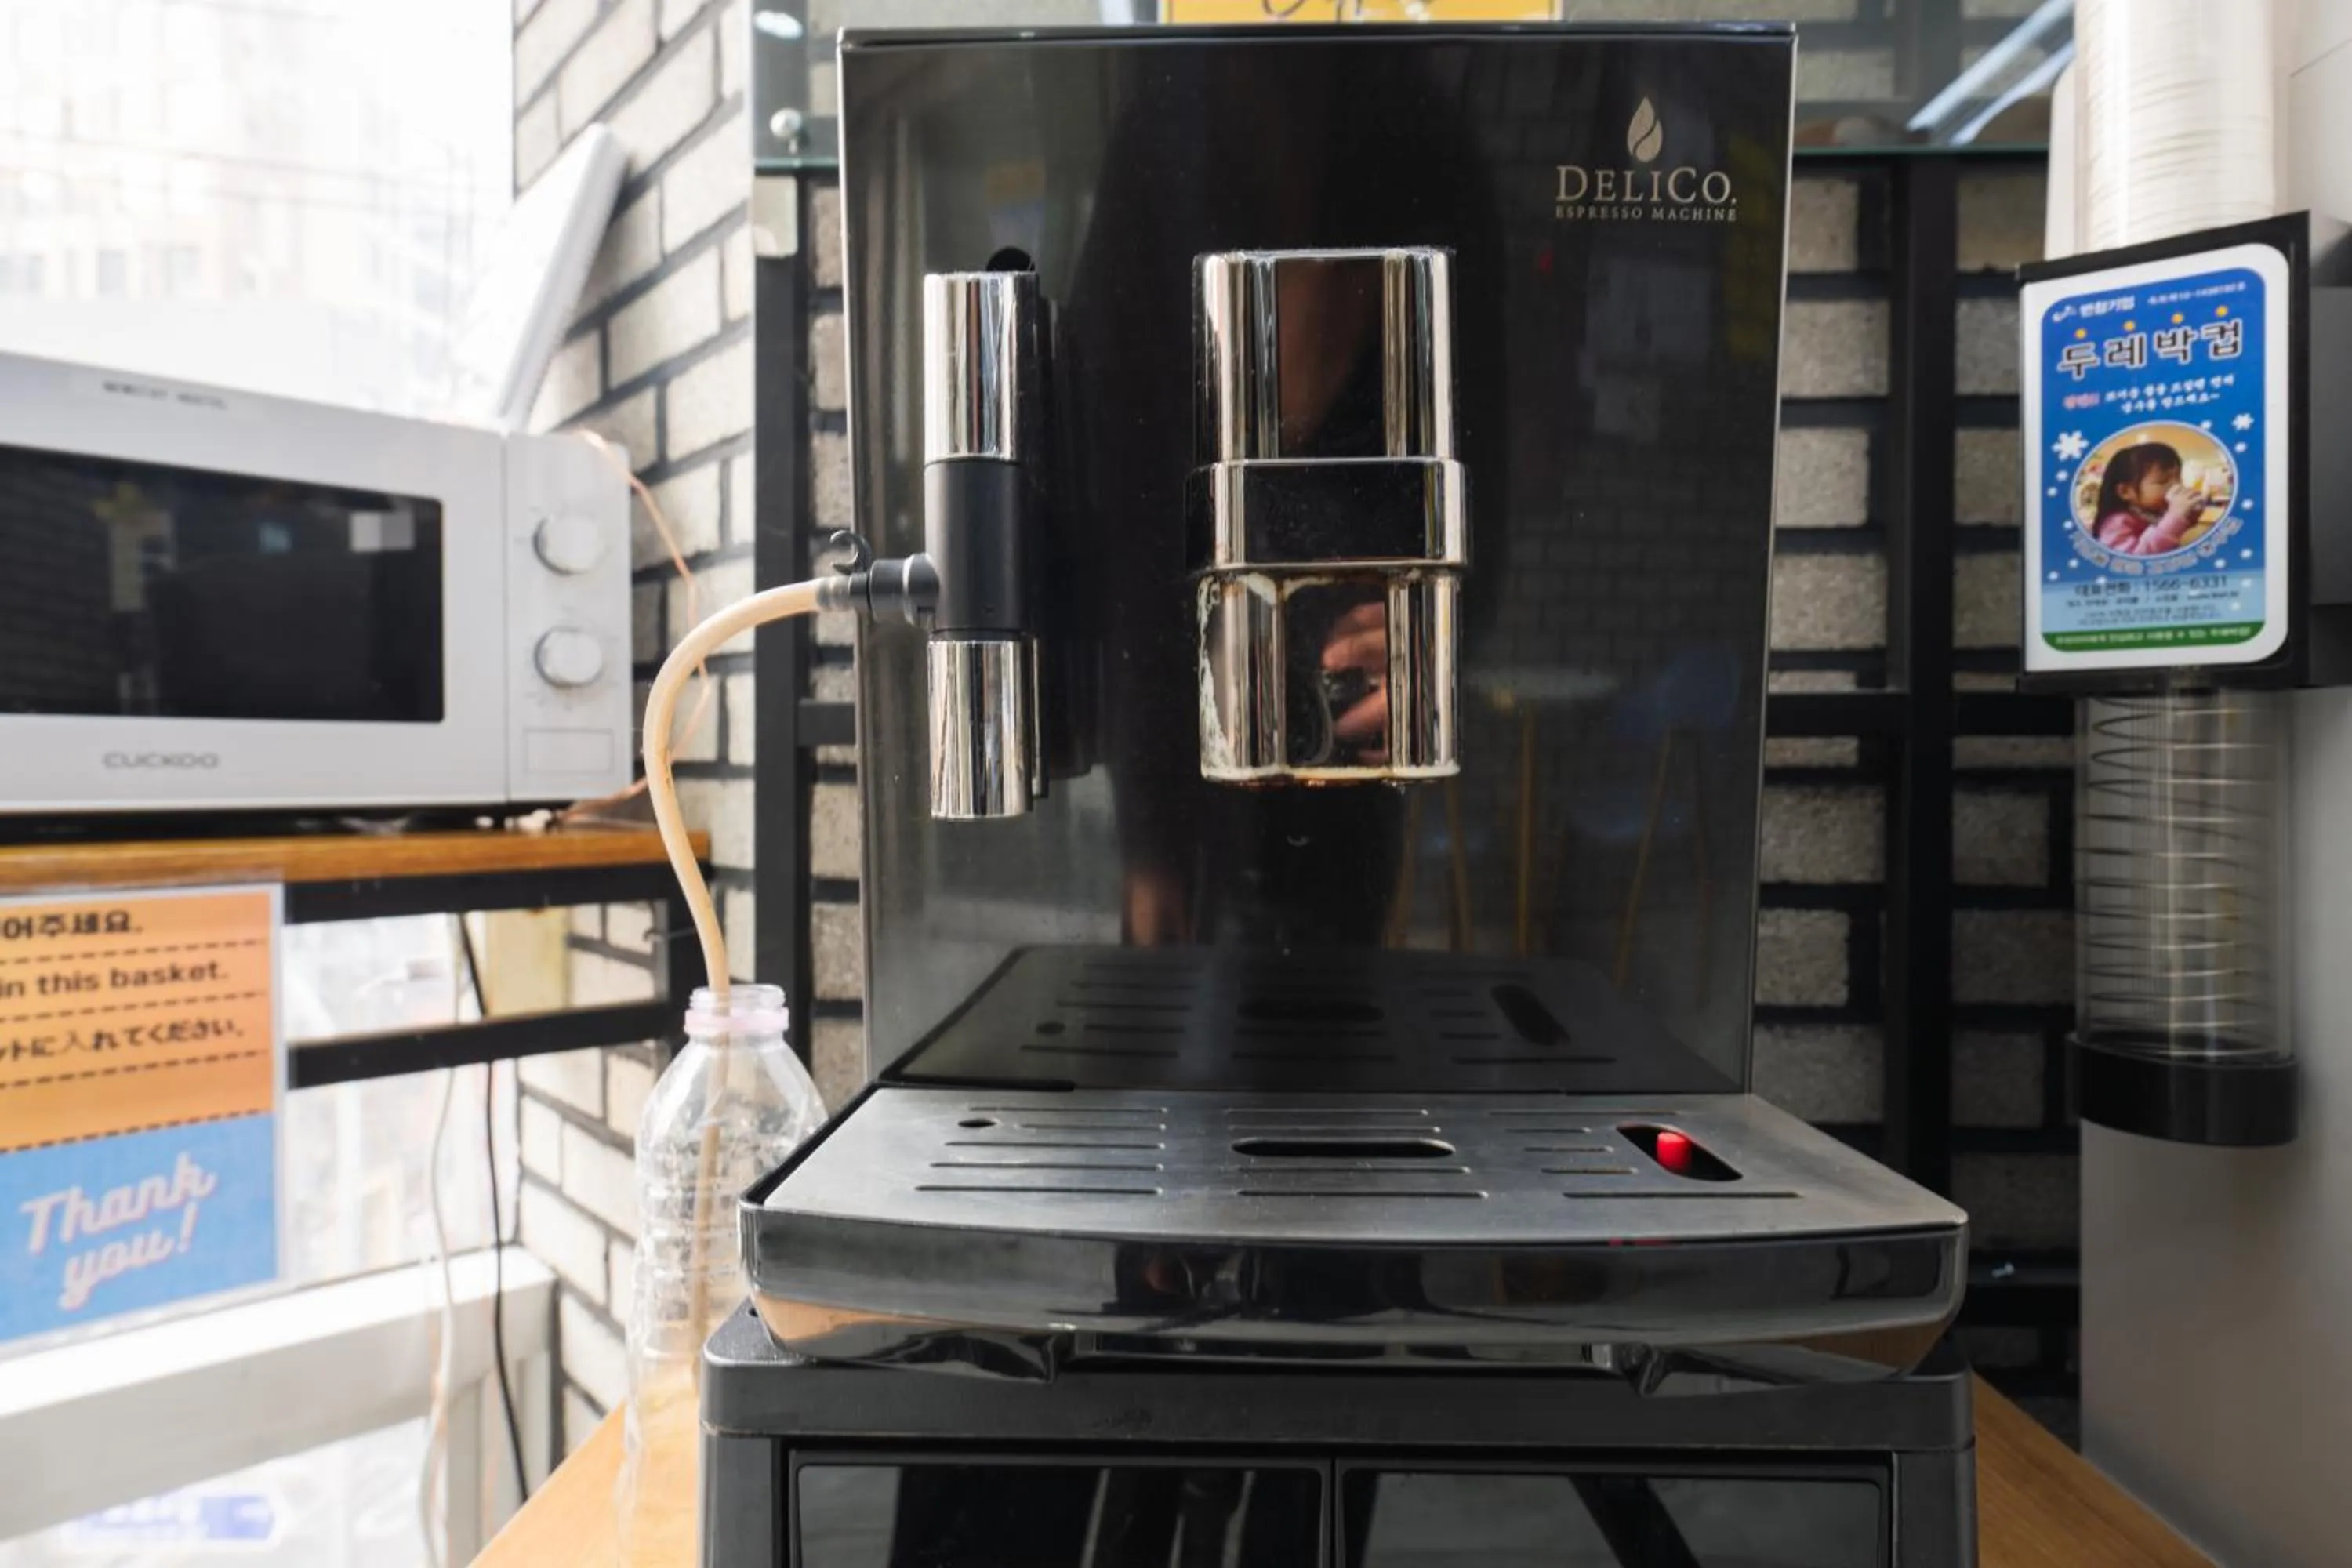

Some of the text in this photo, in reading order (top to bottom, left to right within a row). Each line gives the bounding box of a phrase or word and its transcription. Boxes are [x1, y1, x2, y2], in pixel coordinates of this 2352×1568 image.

[1555, 205, 1737, 221] ESPRESSO MACHINE
[103, 750, 219, 769] CUCKOO
[37, 971, 100, 996] this
[111, 960, 228, 989] basket.
[20, 1151, 218, 1254] Thank
[58, 1200, 198, 1310] you!
